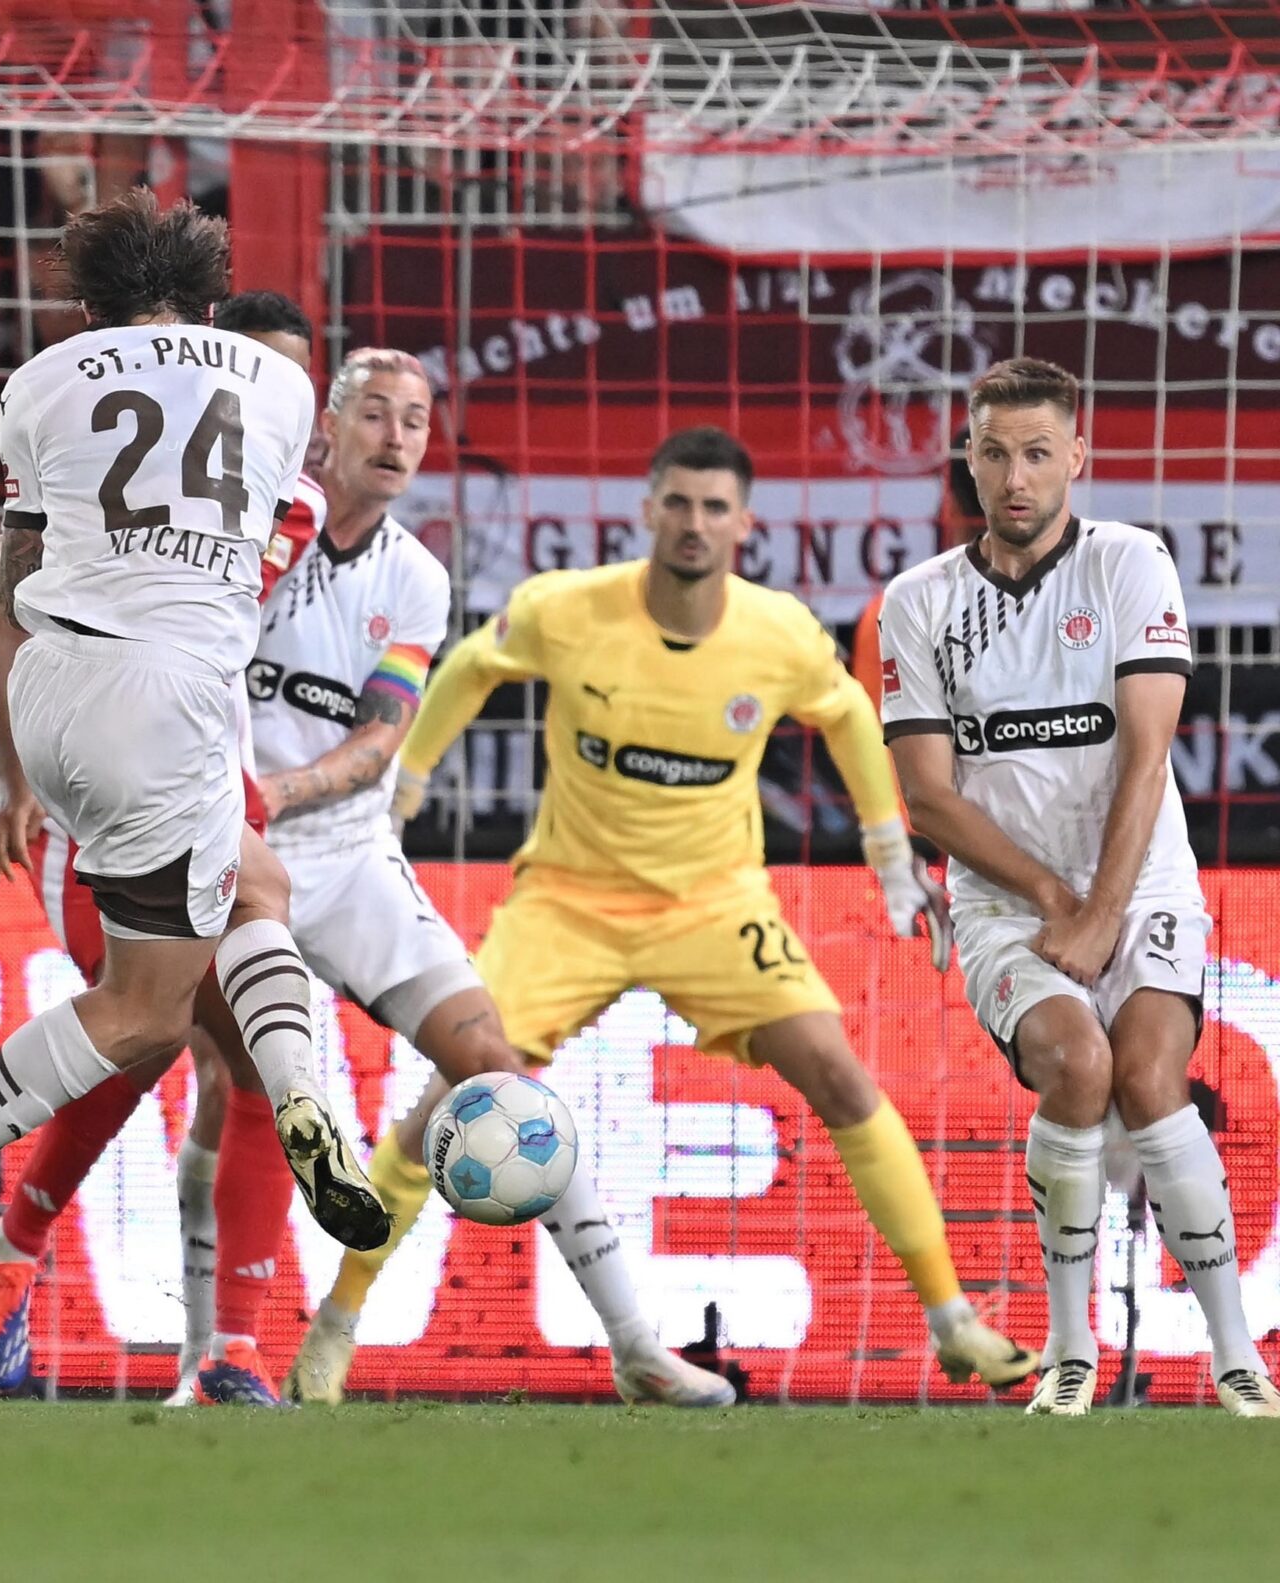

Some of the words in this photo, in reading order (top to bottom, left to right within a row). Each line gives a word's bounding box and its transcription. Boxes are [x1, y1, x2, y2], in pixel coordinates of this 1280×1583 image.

[622, 284, 705, 332] um
[152, 337, 261, 383] PAULI
[91, 388, 249, 538] 24
[994, 713, 1103, 742] congstar
[623, 751, 729, 785] congstar
[740, 920, 805, 972] 22
[1149, 911, 1178, 952] 3
